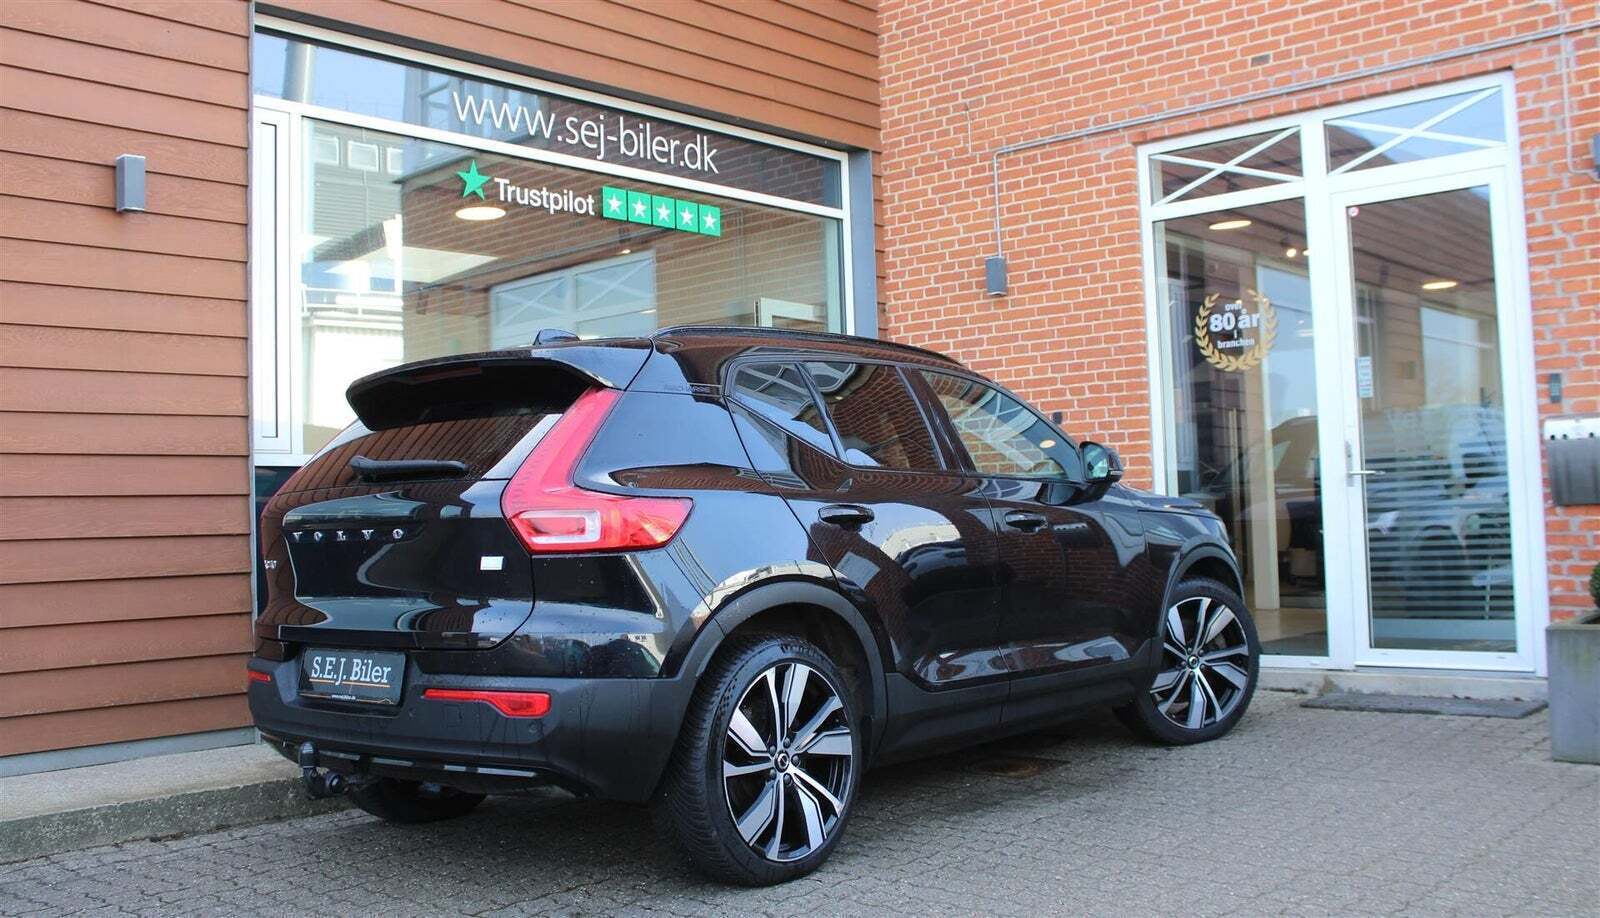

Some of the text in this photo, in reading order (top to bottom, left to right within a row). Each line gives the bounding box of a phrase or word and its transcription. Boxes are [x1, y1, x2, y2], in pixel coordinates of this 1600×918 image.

[453, 91, 719, 174] www.sej-biler.dk
[494, 177, 595, 216] Trustpilot
[1225, 303, 1242, 311] over
[1209, 308, 1261, 332] 80 år
[1217, 338, 1255, 349] branchen
[292, 528, 405, 542] VOLVO
[311, 656, 392, 686] S.E.J. Biler
